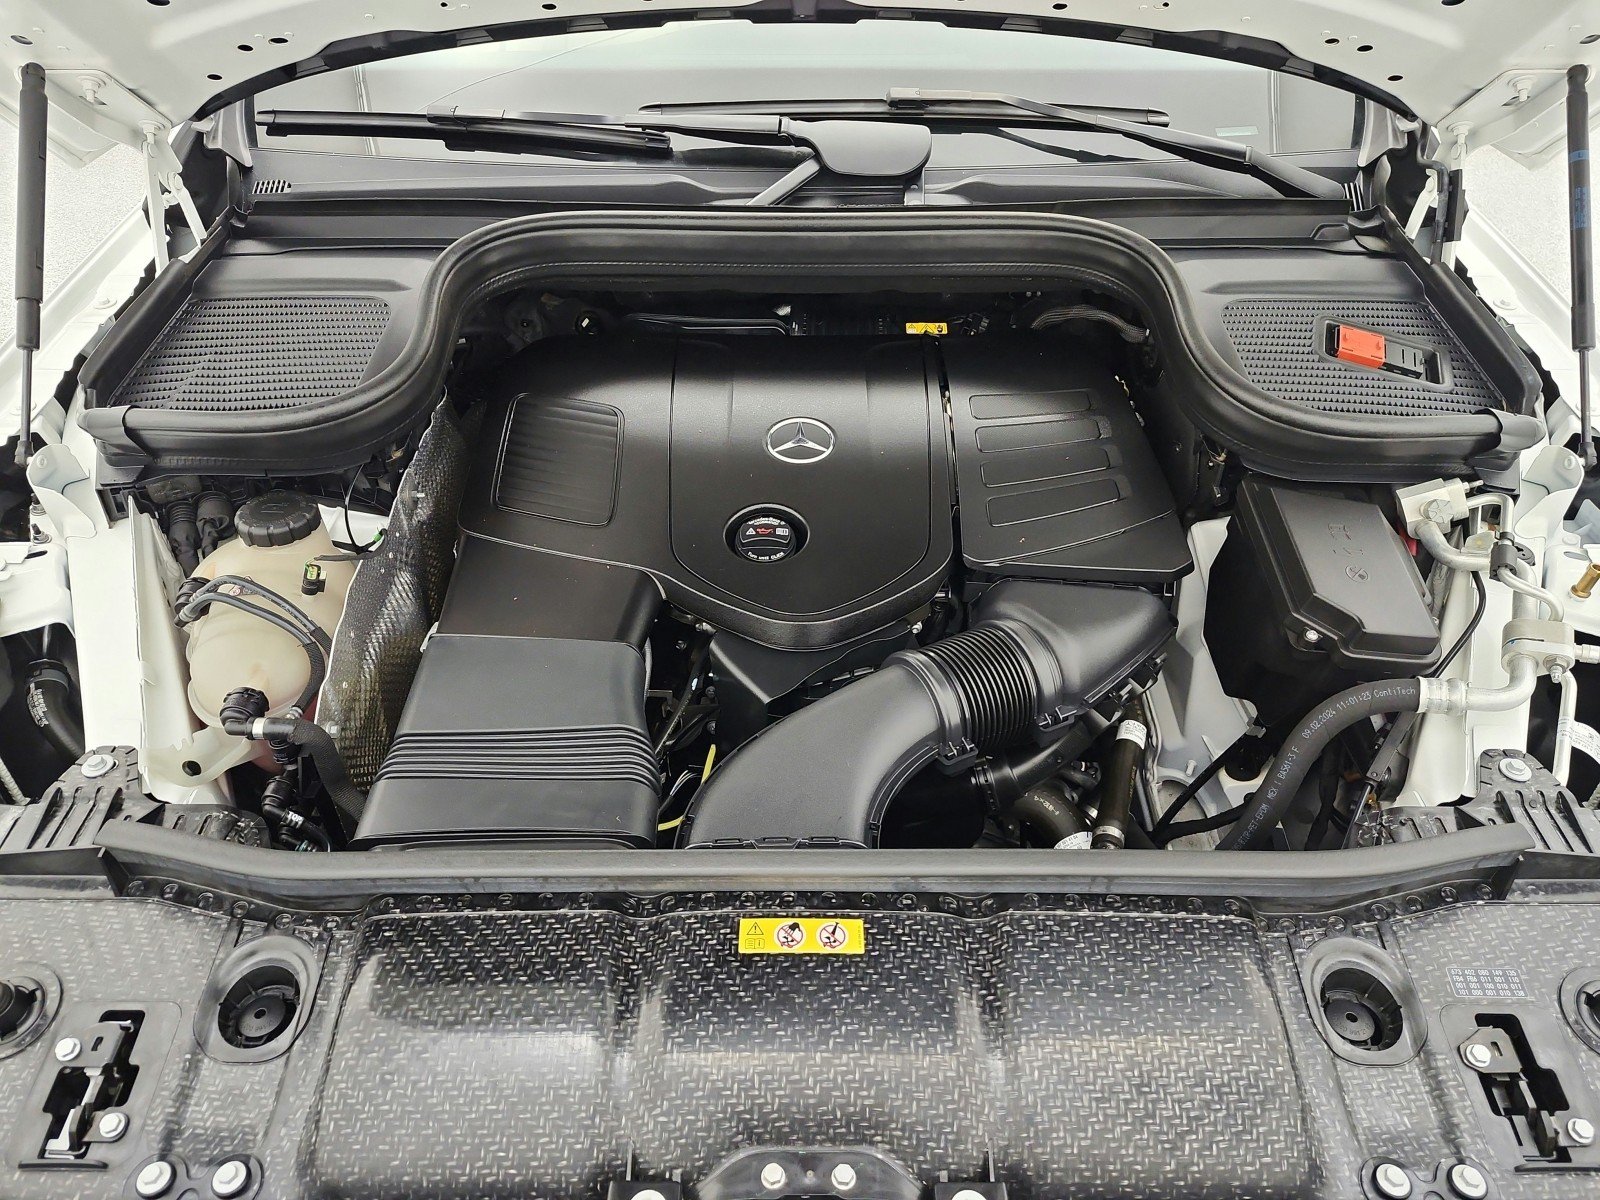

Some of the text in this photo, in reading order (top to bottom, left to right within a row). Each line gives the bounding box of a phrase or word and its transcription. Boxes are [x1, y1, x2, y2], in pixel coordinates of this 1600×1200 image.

[1301, 708, 1336, 739] 09.02.2024
[1336, 691, 1372, 711] 11:01:23
[1373, 686, 1416, 698] ContiTech
